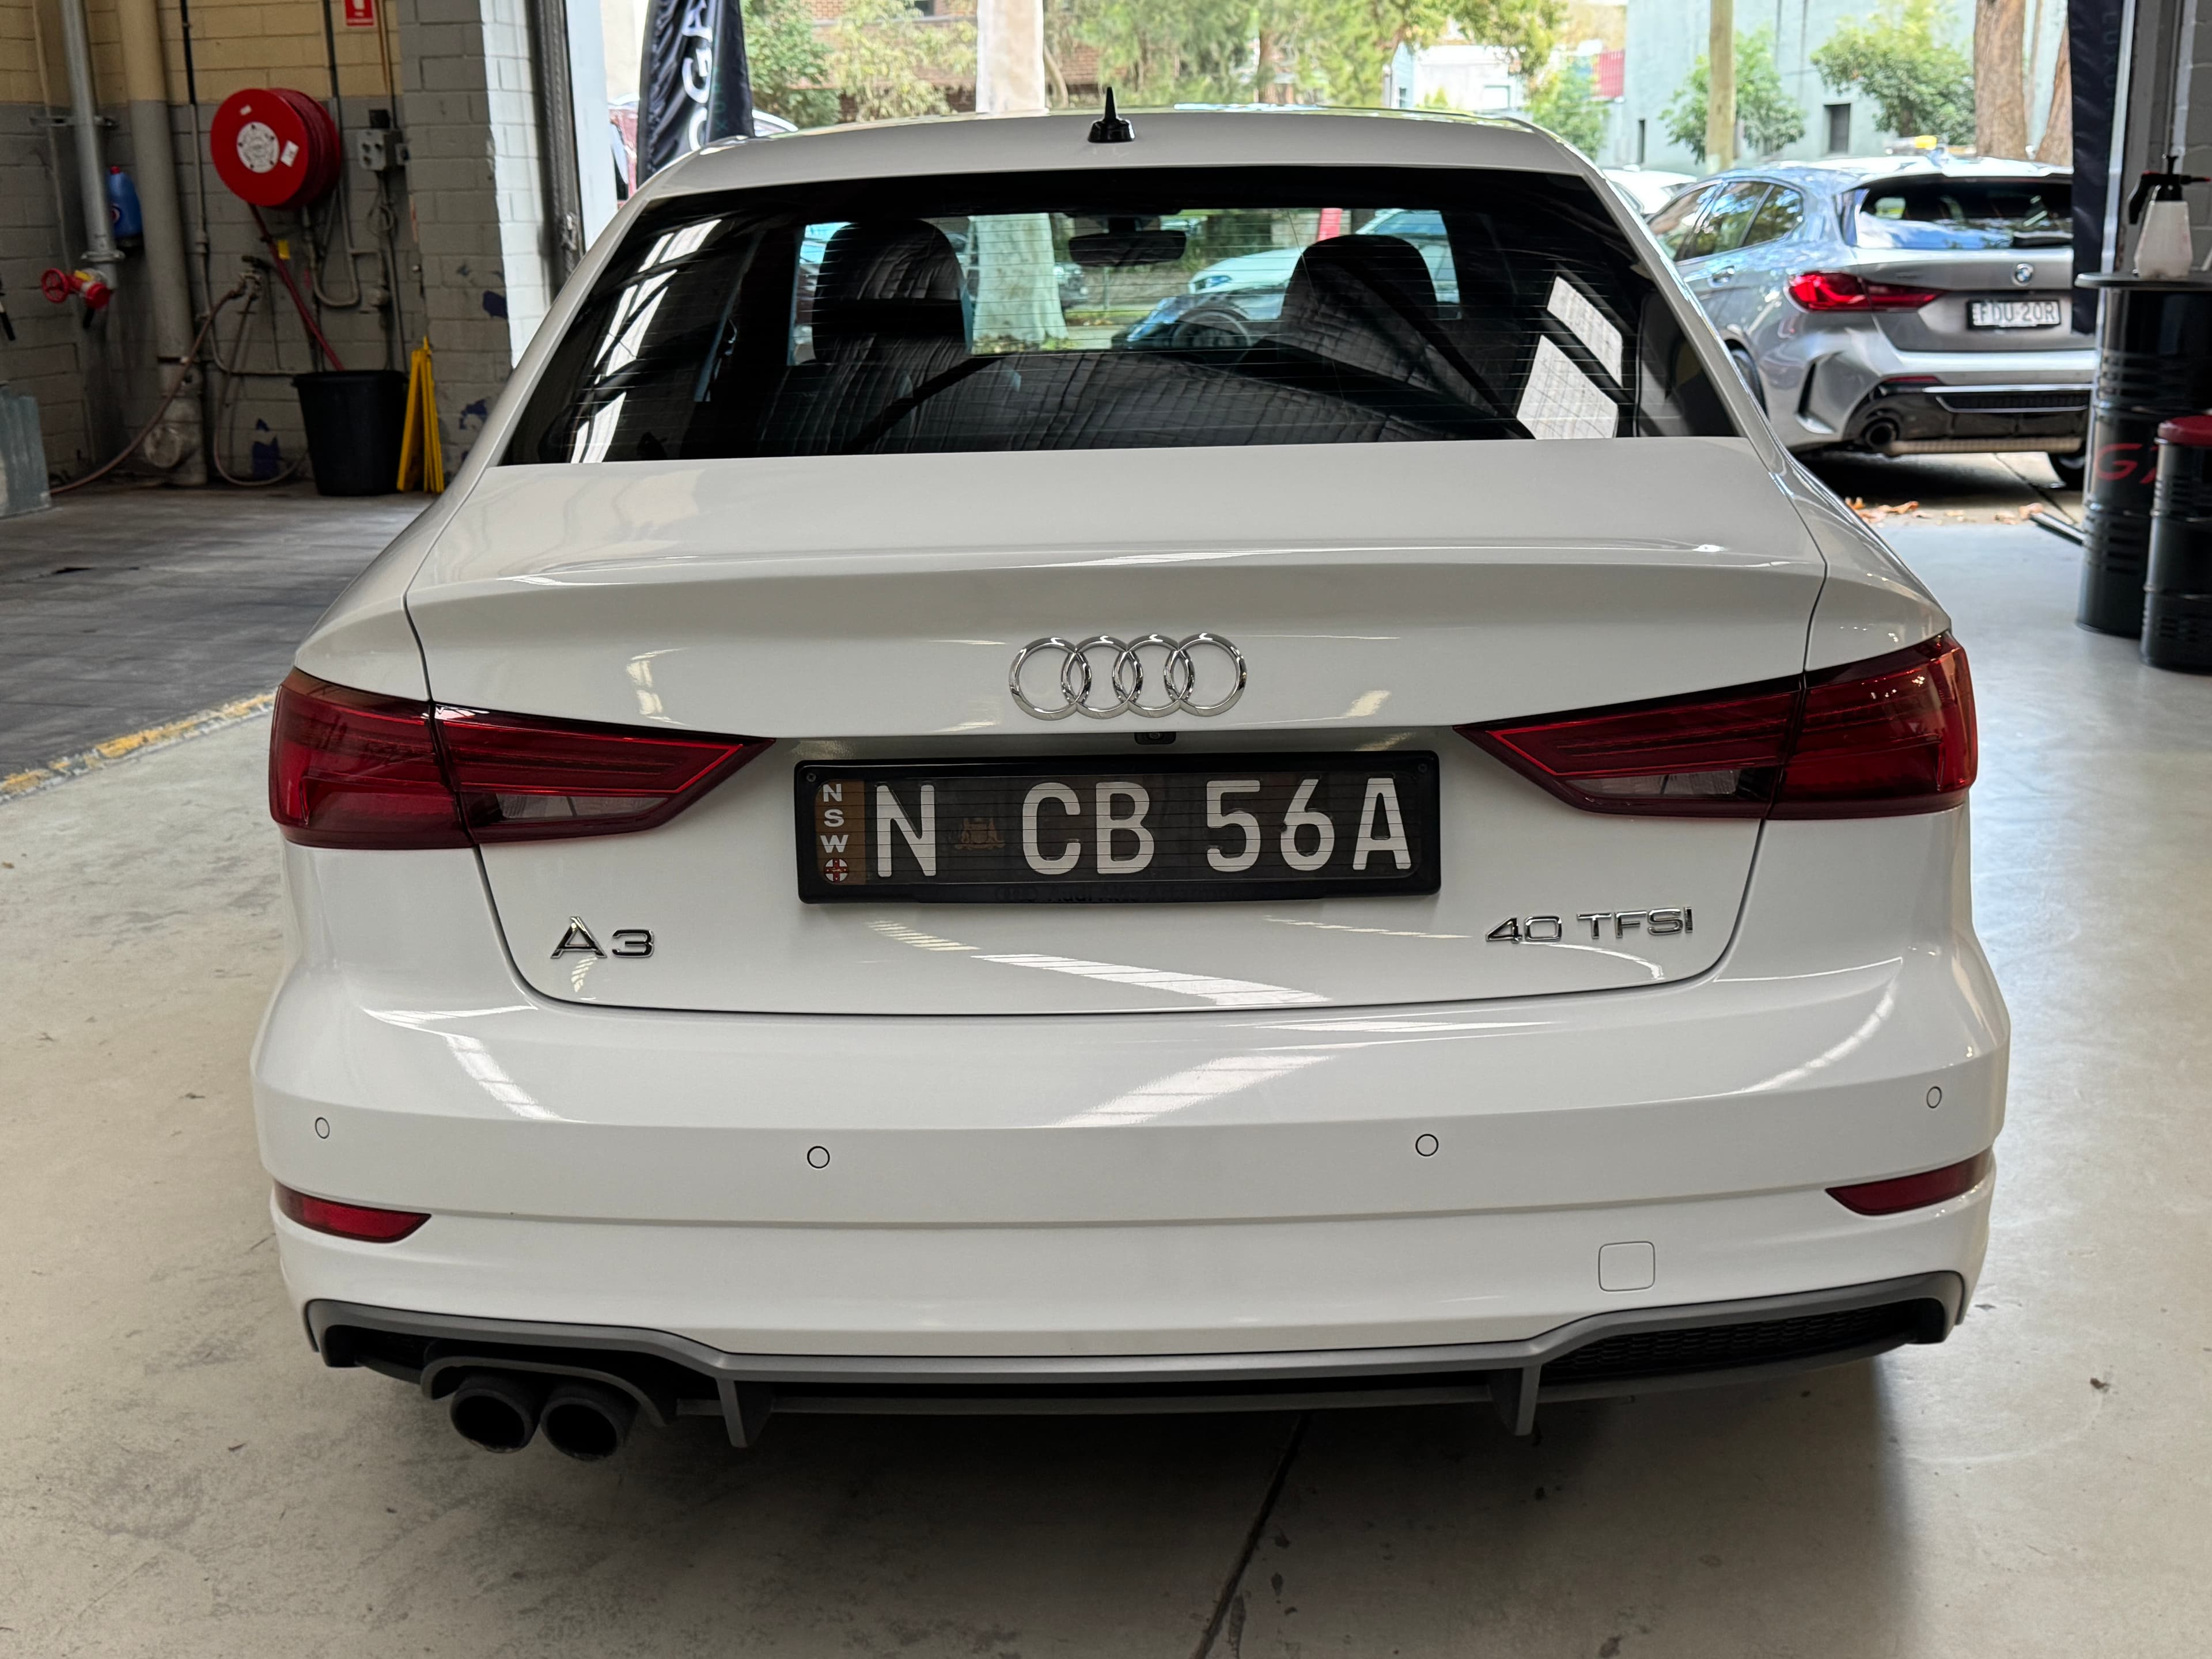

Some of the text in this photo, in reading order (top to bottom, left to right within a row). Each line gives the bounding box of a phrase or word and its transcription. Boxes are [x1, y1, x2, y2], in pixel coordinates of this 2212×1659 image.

[820, 783, 849, 853] NSW
[876, 778, 1411, 877] N CB 56A
[550, 916, 655, 959] A3
[1486, 906, 1694, 944] 40 TFSI
